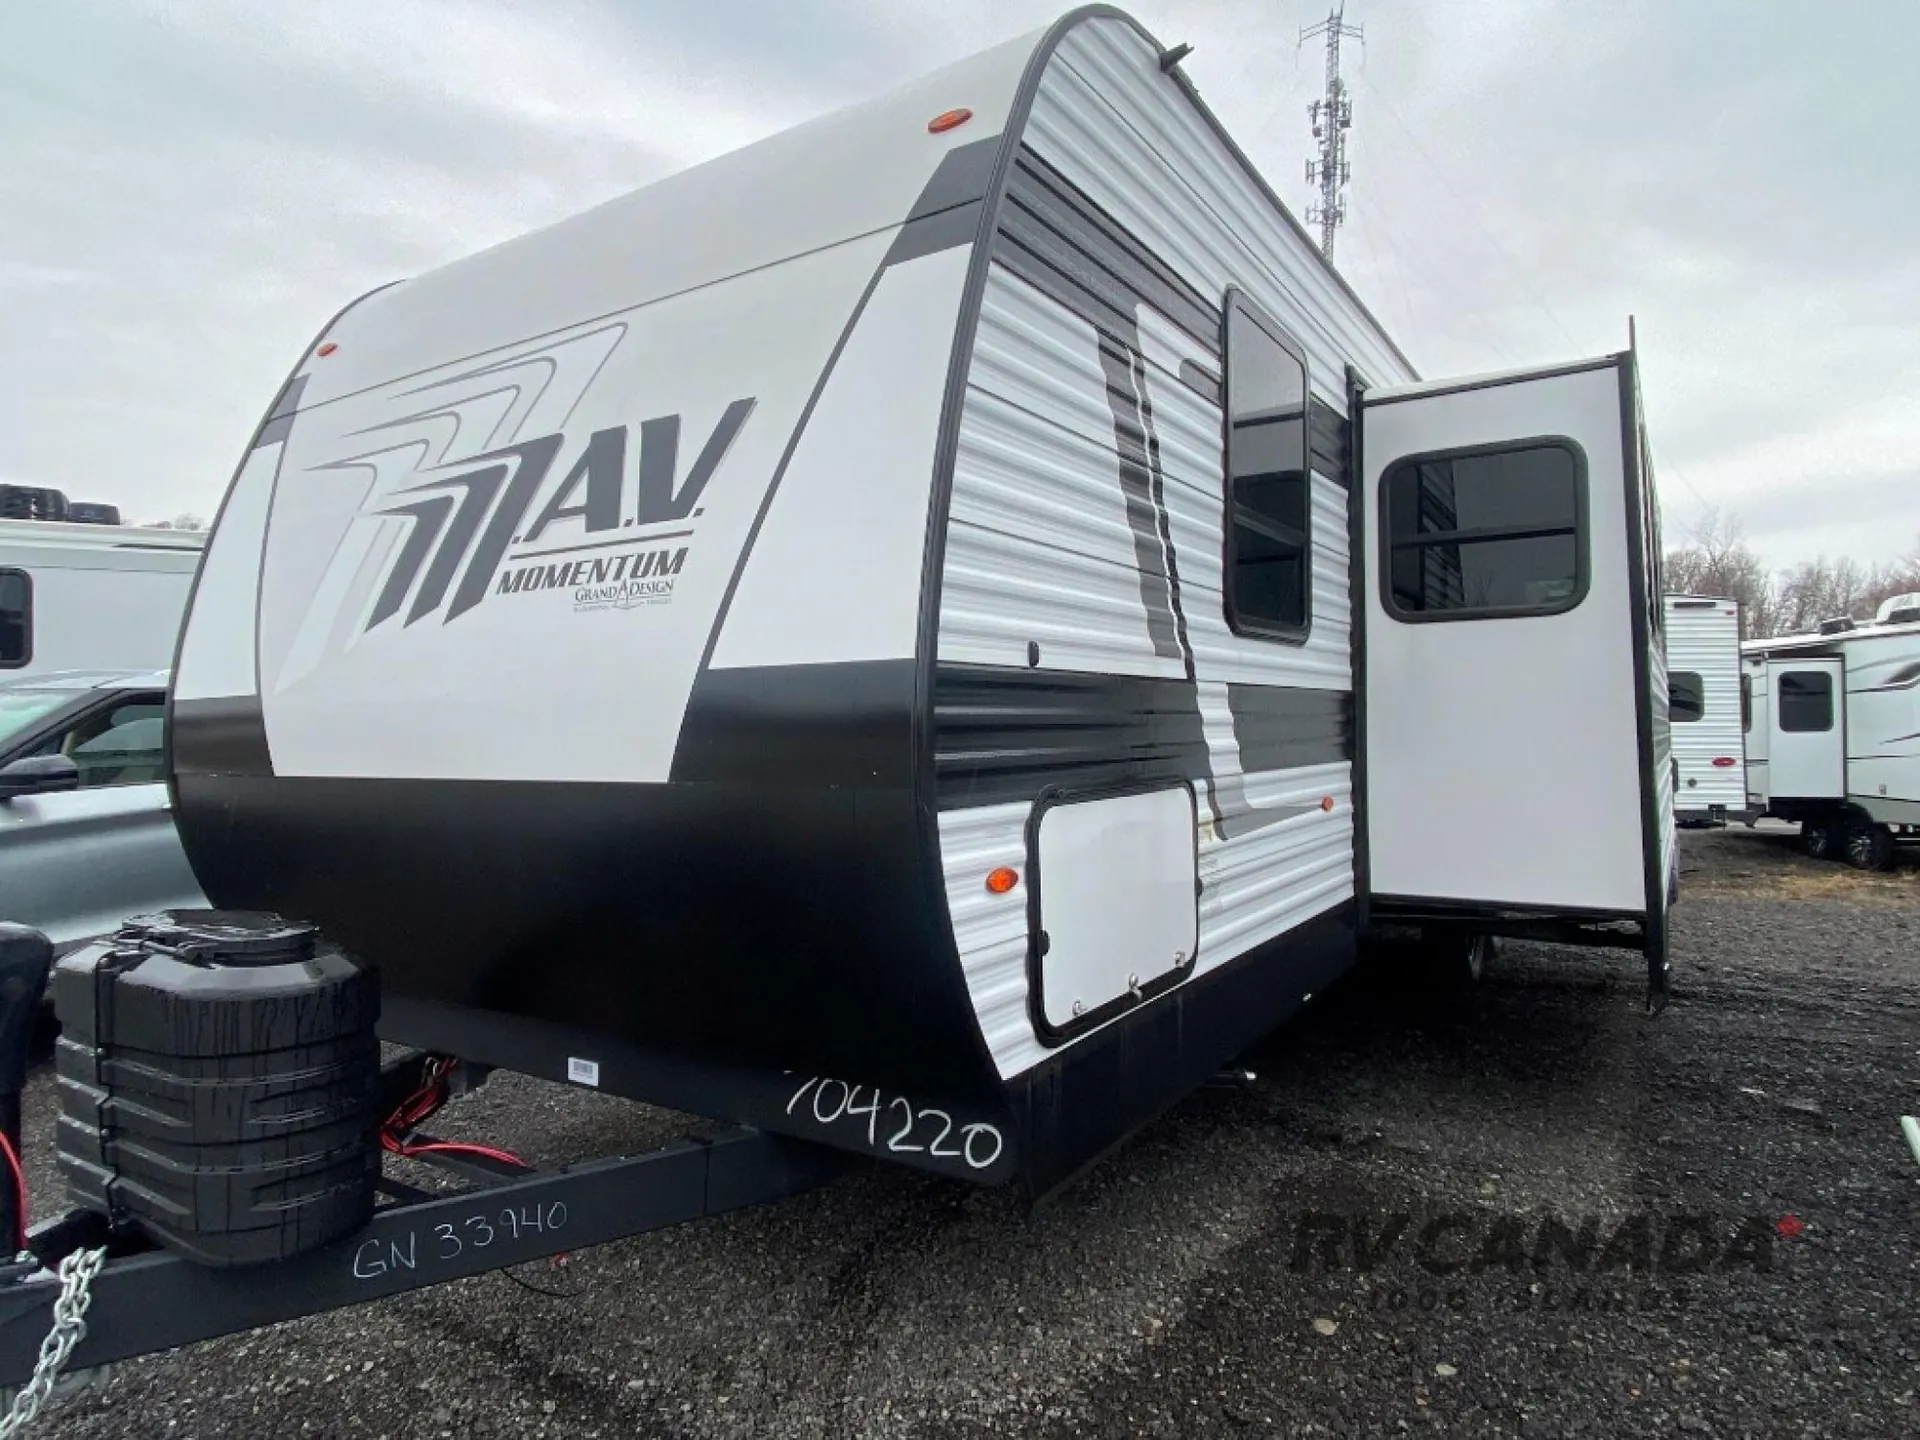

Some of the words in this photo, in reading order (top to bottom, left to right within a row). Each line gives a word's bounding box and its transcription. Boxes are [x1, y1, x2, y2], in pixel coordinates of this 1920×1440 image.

[495, 546, 690, 595] MOMENTUM
[574, 586, 619, 602] GRAND
[629, 578, 674, 597] DESIGN
[353, 1231, 416, 1278] GN
[434, 1201, 568, 1260] 33940
